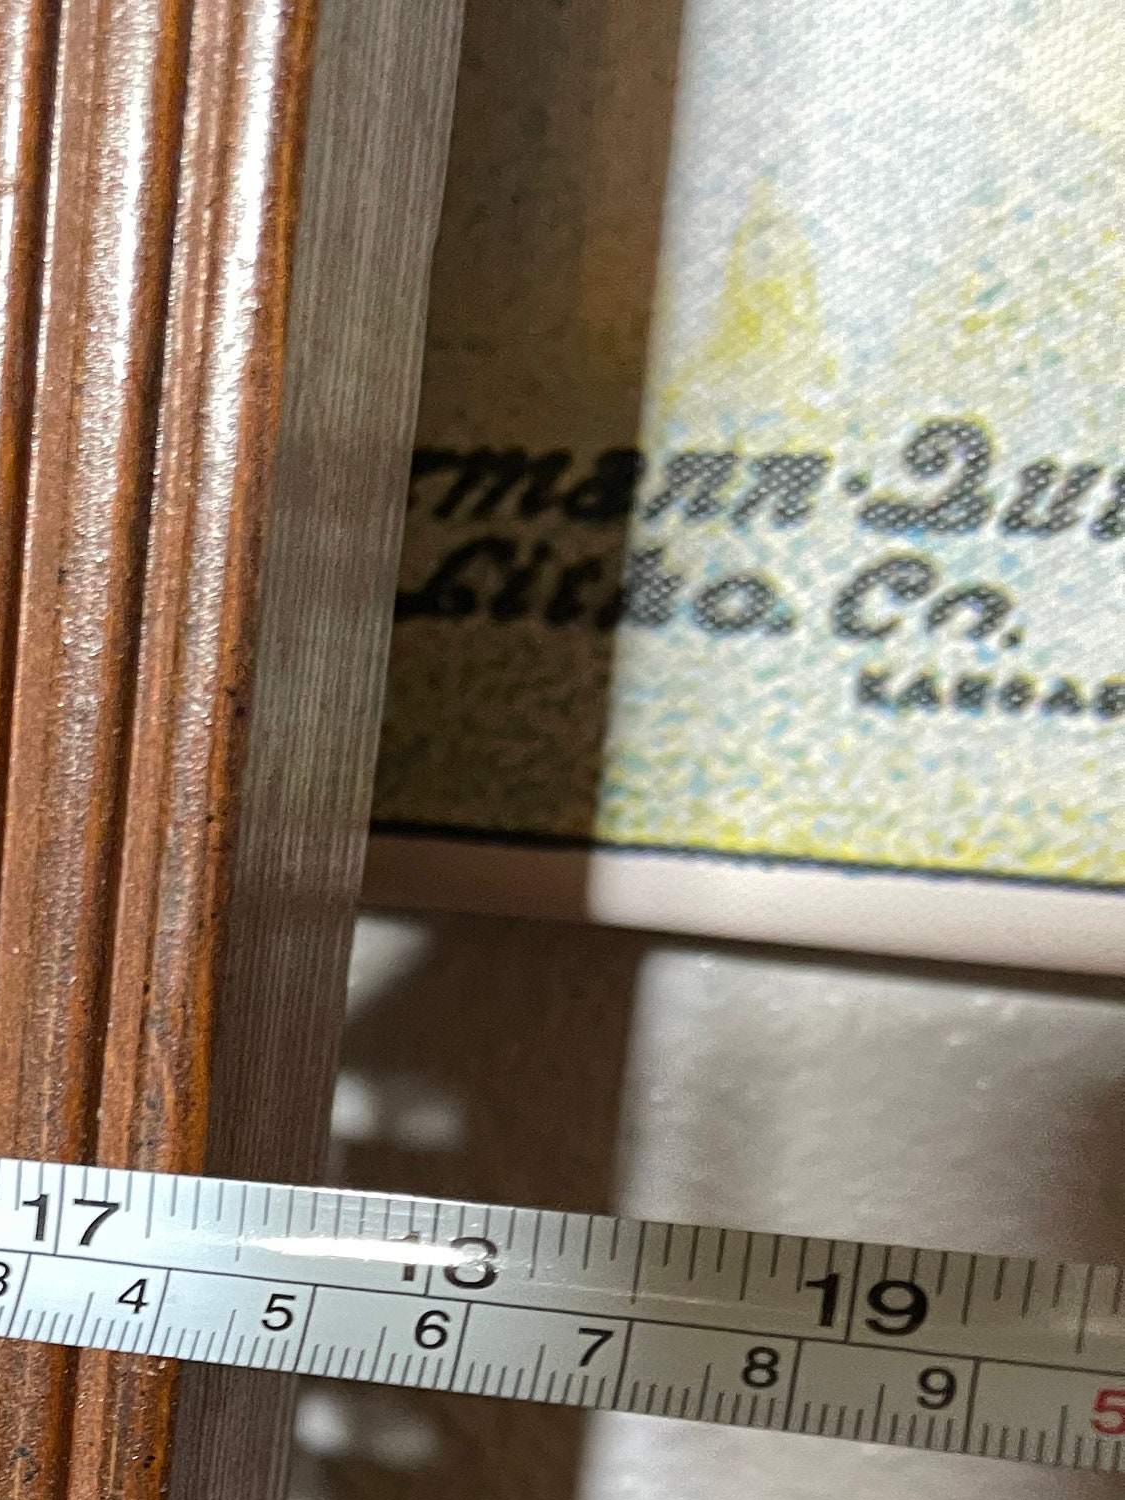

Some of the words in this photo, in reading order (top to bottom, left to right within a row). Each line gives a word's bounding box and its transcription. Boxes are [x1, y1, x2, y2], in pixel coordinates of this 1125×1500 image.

[22, 1193, 120, 1247] 17
[805, 1272, 929, 1337] 19
[117, 1277, 150, 1316] 4
[260, 1293, 297, 1332] 5
[414, 1309, 450, 1350] 6
[577, 1327, 615, 1367] 7
[741, 1345, 780, 1389] 8
[916, 1366, 957, 1410] 9
